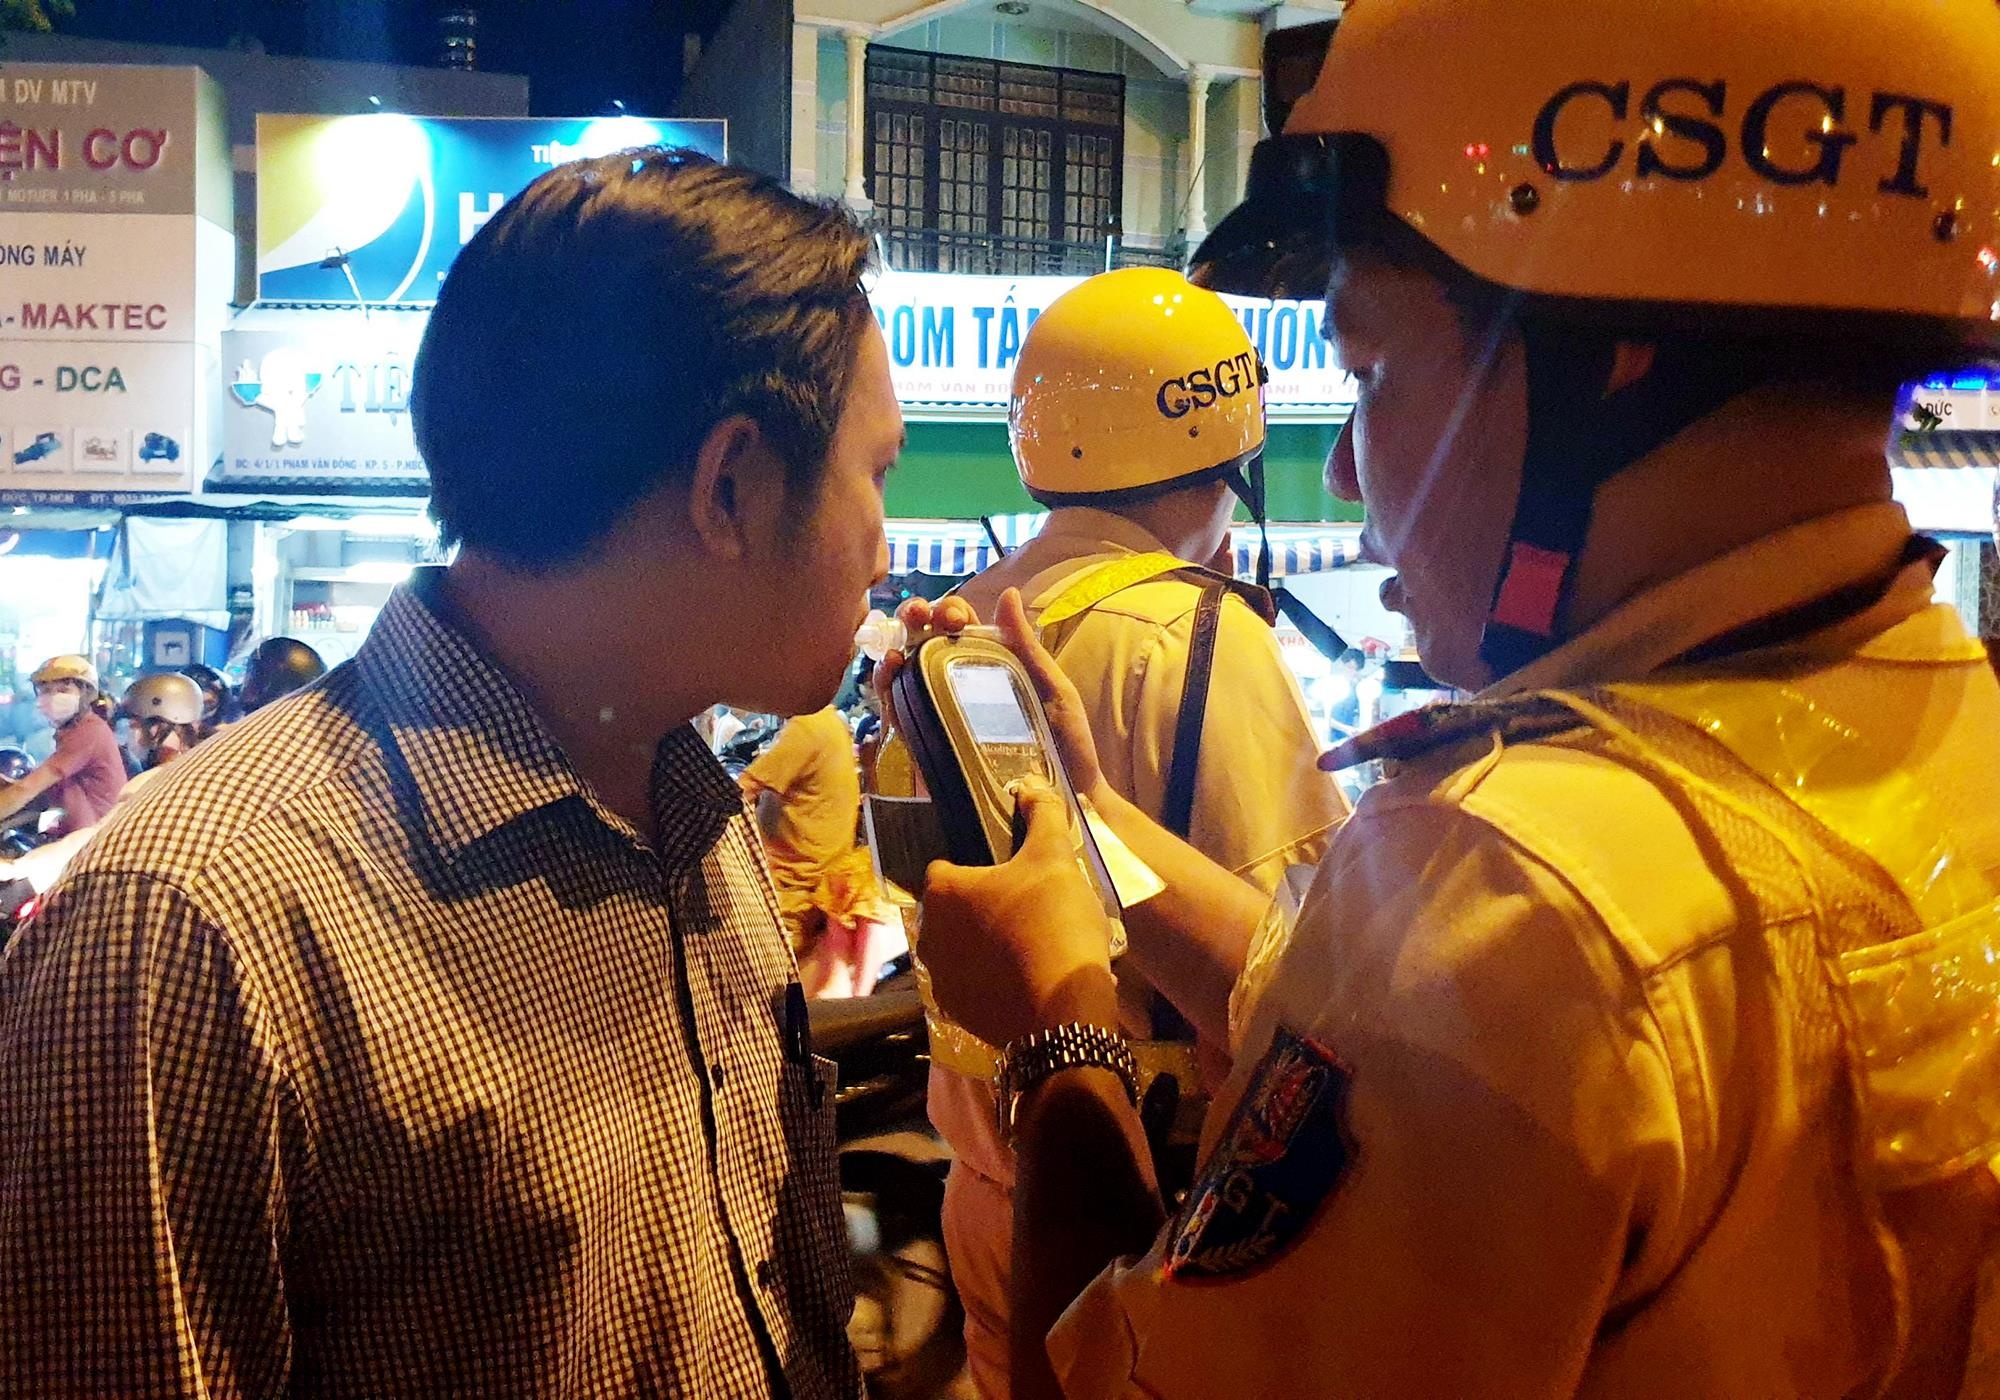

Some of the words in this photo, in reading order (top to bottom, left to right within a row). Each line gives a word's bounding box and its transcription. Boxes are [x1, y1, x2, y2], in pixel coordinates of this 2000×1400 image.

[14, 79, 42, 103] DV
[52, 80, 97, 104] MTV
[83, 127, 168, 171] CƠ
[1532, 77, 1954, 199] CSGT
[44, 240, 86, 266] MÁY
[22, 303, 167, 330] MAKTEC
[56, 366, 127, 392] DCA
[1157, 352, 1255, 418] CSGT
